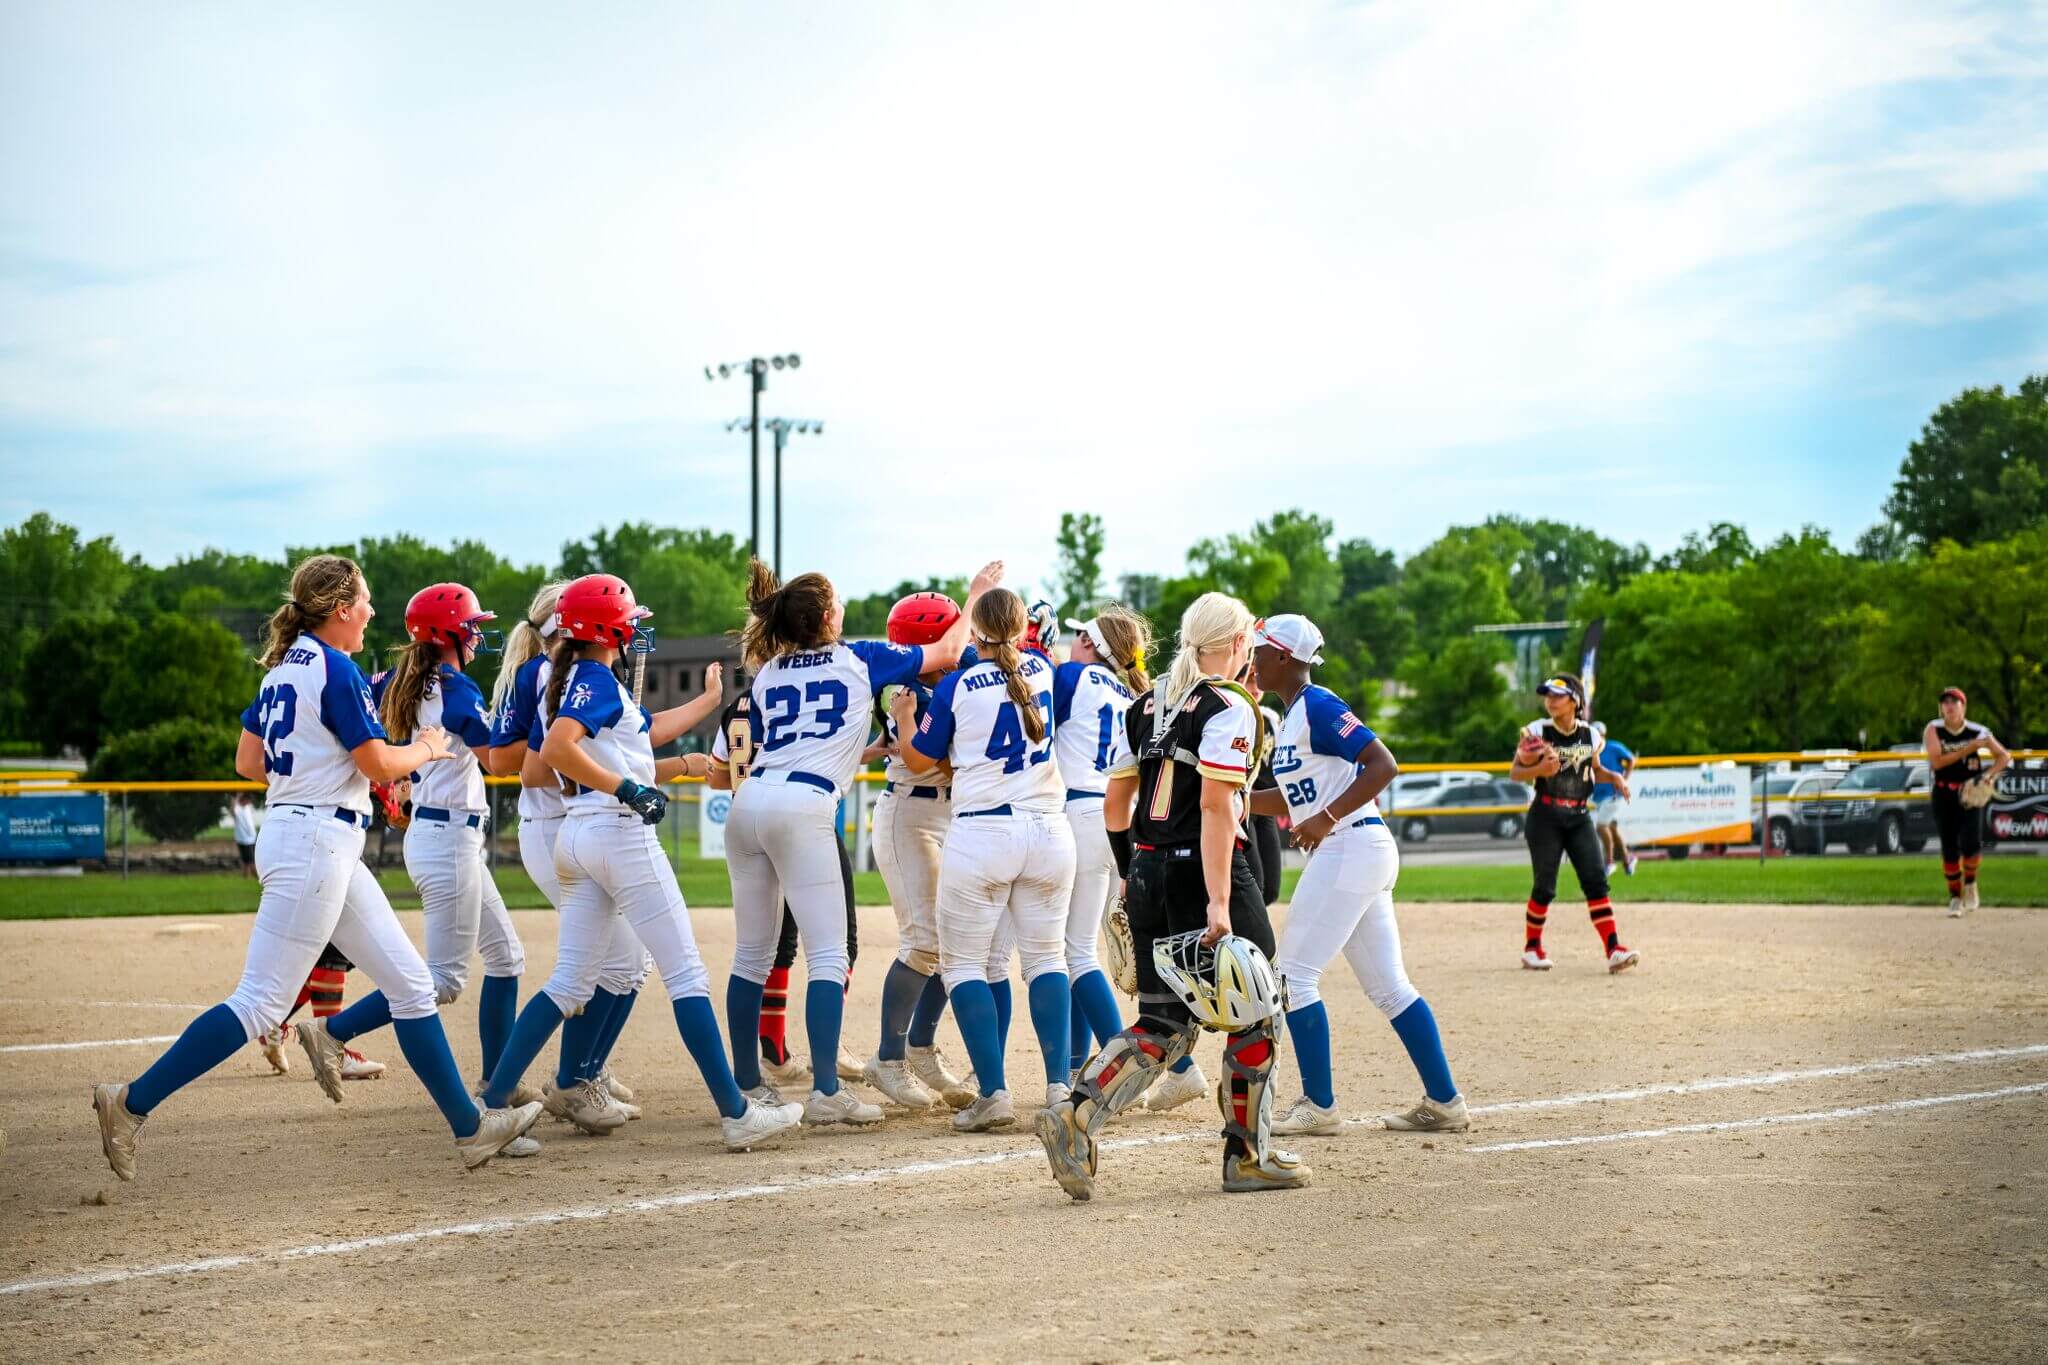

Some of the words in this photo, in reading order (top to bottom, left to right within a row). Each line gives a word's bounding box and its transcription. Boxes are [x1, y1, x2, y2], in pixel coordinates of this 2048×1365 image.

[778, 651, 833, 670] WEBER
[963, 658, 1044, 692] MILKOSKI
[763, 679, 848, 753] 23
[1285, 777, 1318, 808] 28
